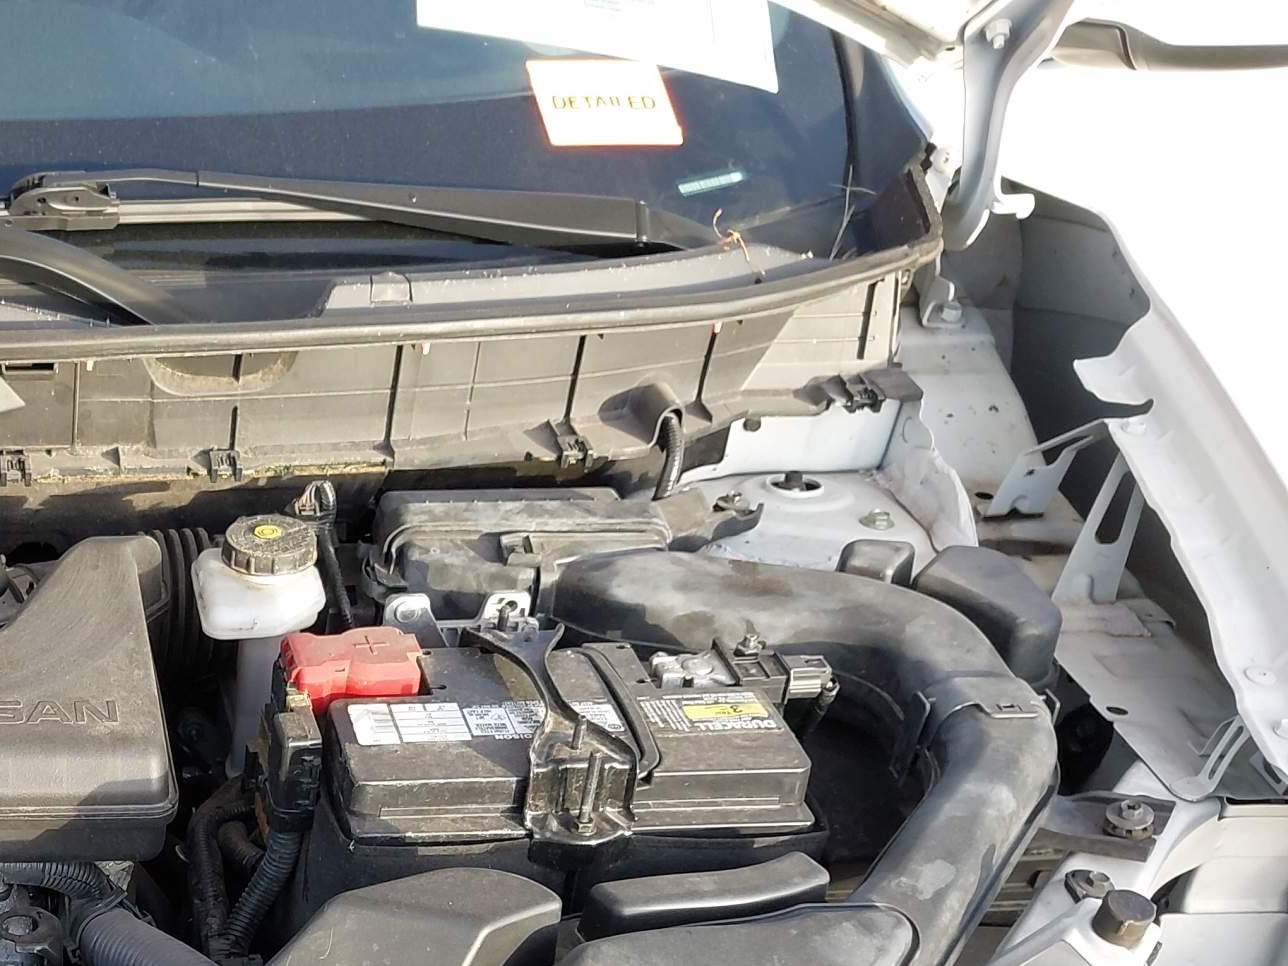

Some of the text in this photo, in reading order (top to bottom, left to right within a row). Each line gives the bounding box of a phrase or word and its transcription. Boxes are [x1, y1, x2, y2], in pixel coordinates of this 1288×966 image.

[552, 95, 656, 111] DETAILED
[693, 718, 778, 732] DURACELL
[494, 733, 534, 741] OISON
